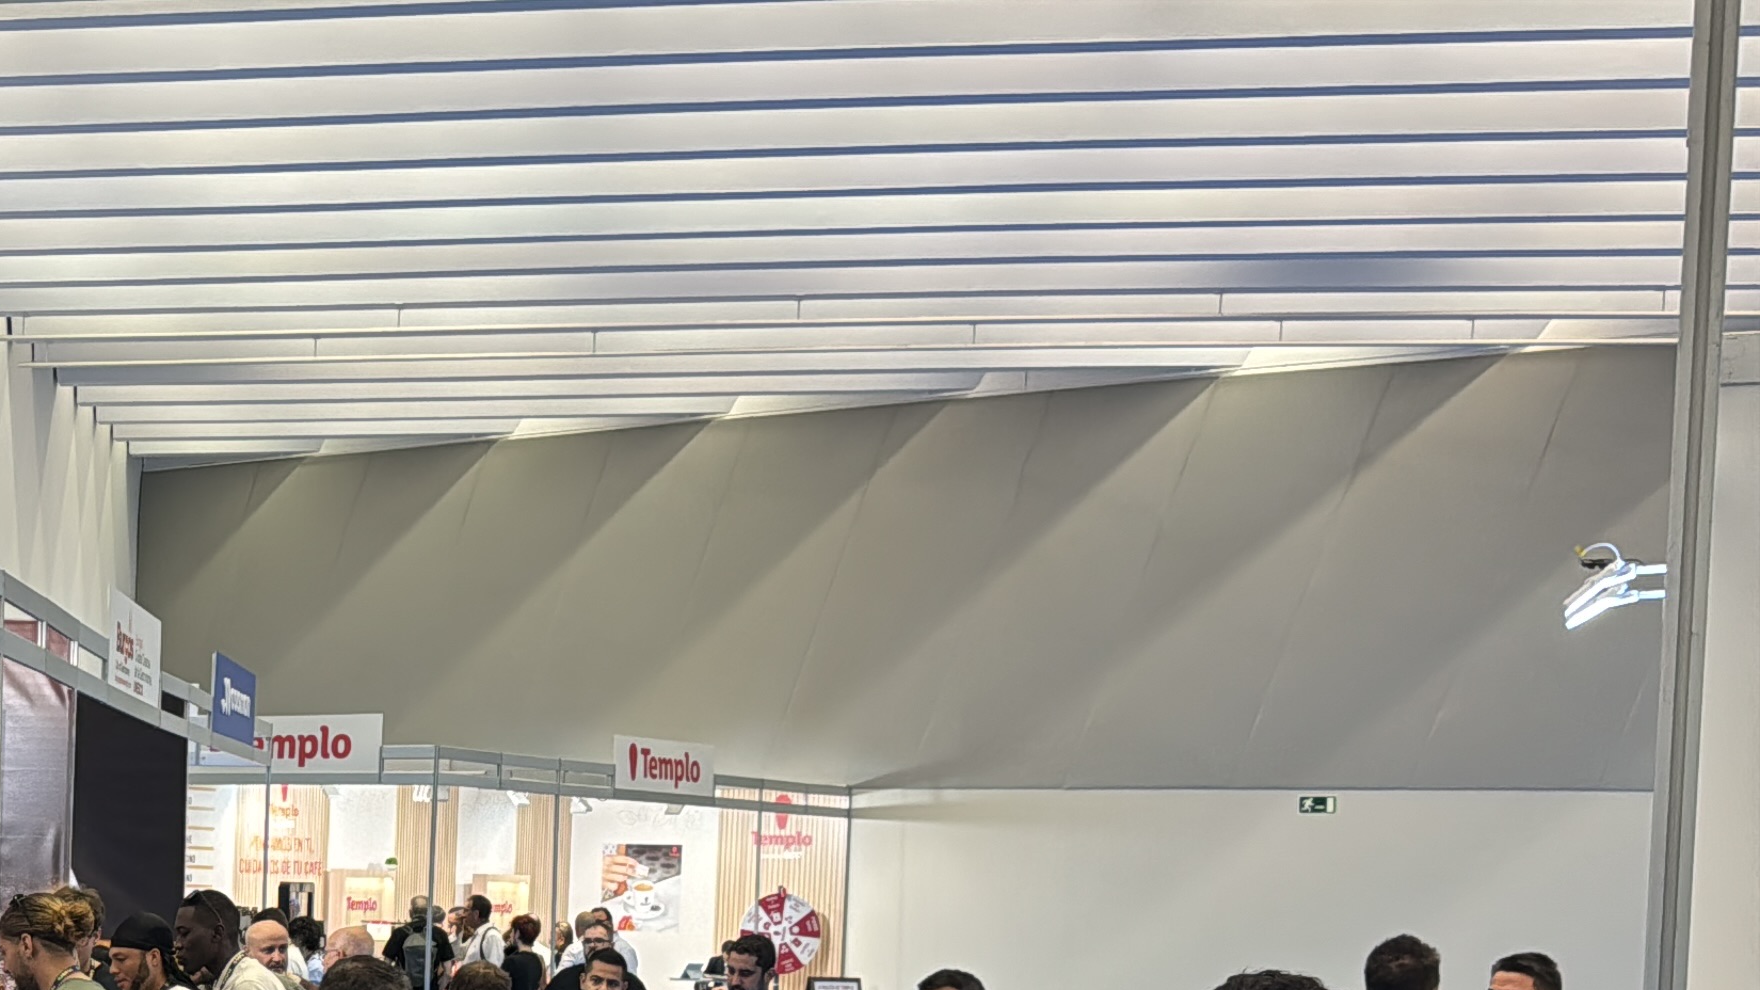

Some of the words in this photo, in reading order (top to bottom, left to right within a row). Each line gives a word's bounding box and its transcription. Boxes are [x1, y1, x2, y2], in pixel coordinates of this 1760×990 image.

[641, 747, 702, 789] Templo
[751, 831, 813, 851] Templo
[239, 858, 279, 875] CUIDAOS
[346, 896, 377, 913] Templo
